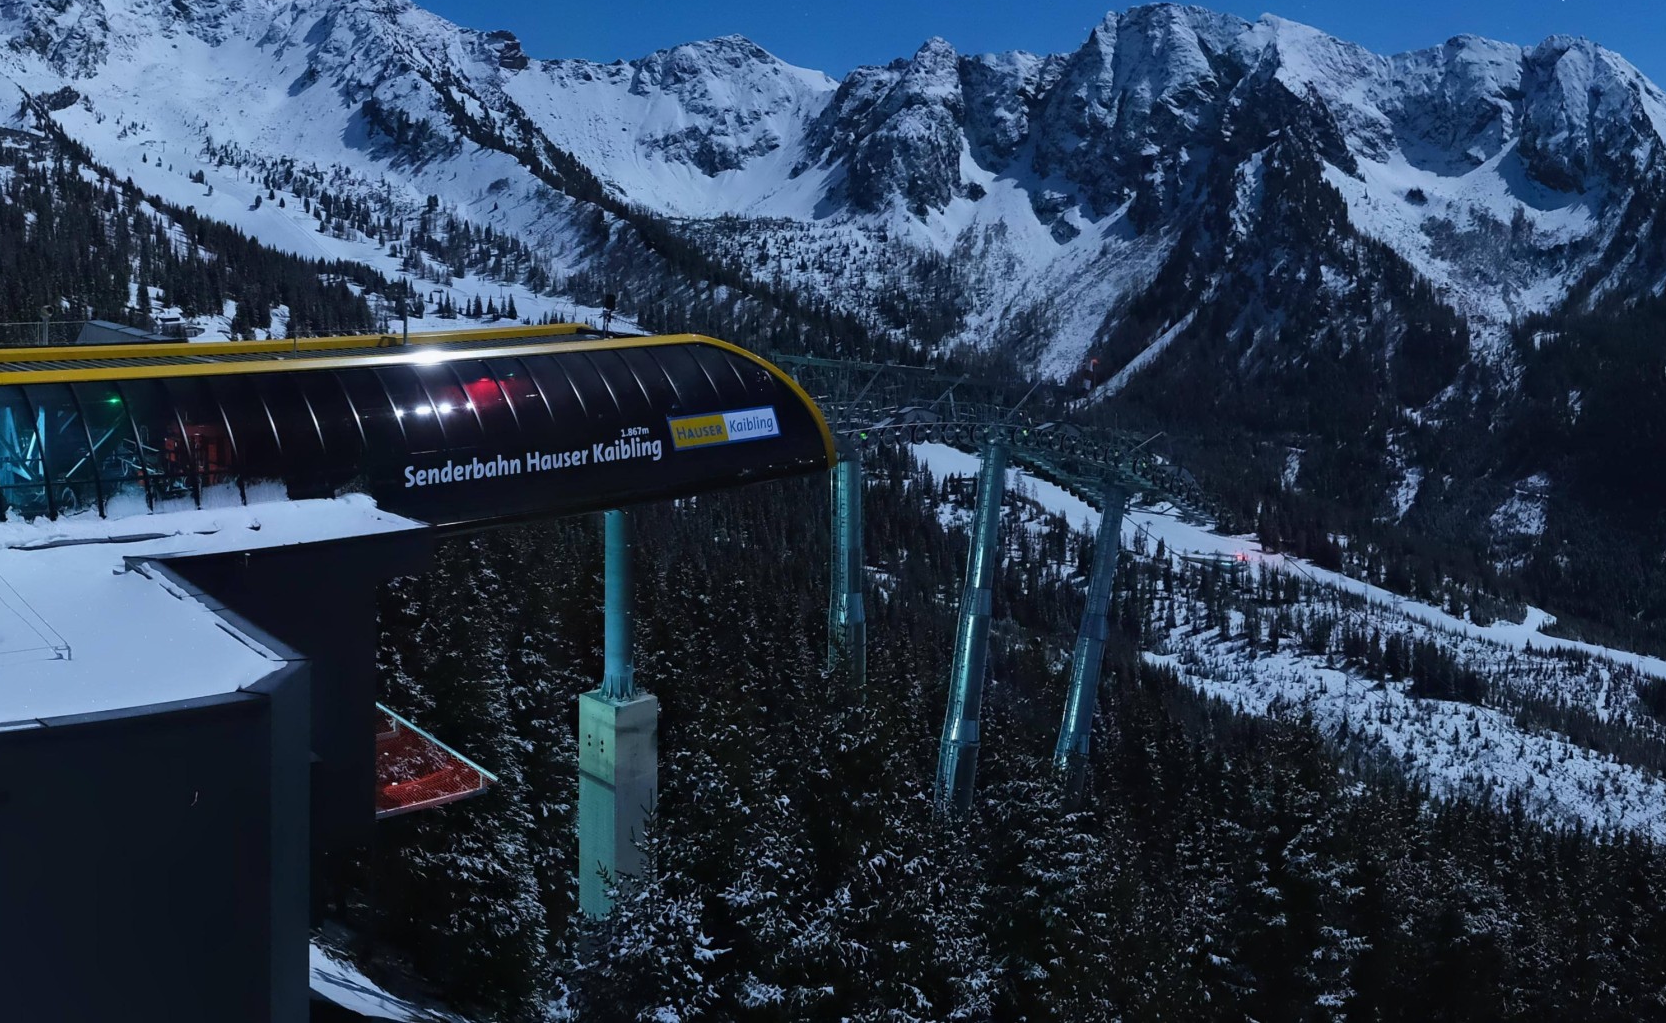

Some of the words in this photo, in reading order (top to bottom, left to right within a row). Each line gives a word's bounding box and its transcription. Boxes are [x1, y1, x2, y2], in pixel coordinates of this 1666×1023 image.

[620, 426, 649, 438] 1.867m
[676, 425, 723, 440] HAUSER
[729, 417, 773, 433] Kaibling
[404, 454, 521, 488] Senderbahn
[526, 449, 589, 473] Hauser
[592, 437, 662, 463] Kaibling
